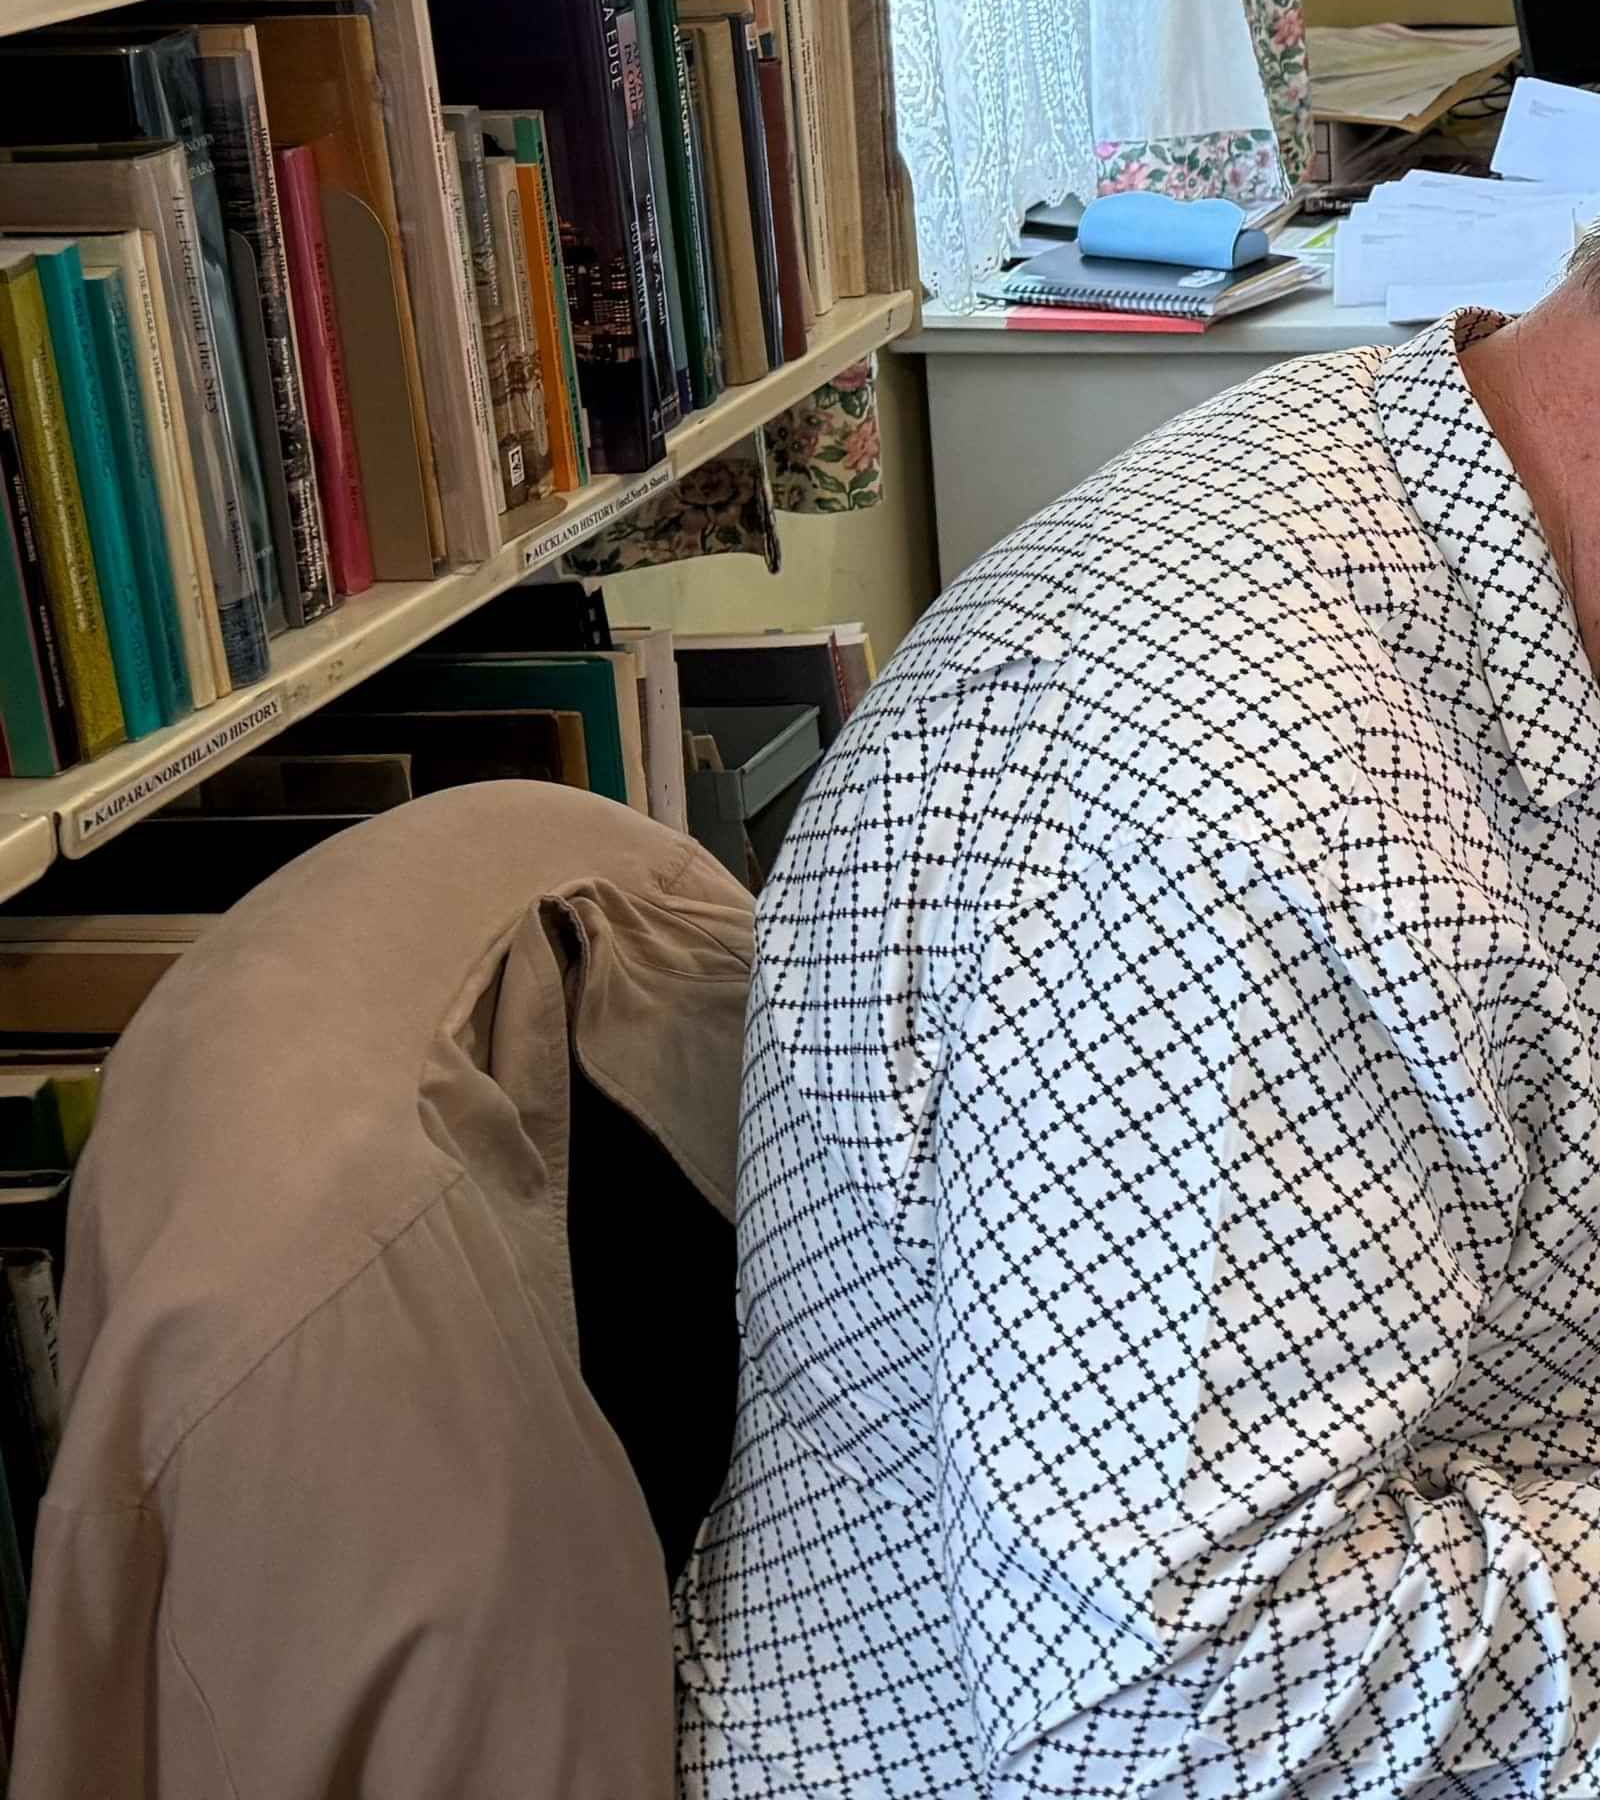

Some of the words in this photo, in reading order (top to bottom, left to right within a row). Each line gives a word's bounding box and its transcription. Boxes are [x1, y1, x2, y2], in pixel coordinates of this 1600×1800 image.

[603, 29, 624, 90] EDGE
[169, 194, 187, 230] The
[178, 239, 198, 284] Rock
[188, 294, 207, 331] and
[196, 340, 214, 371] the
[200, 375, 223, 415] Sky
[532, 521, 580, 561] AUCKLAND
[580, 503, 614, 533] HISTORY
[229, 701, 279, 743] HISTORY
